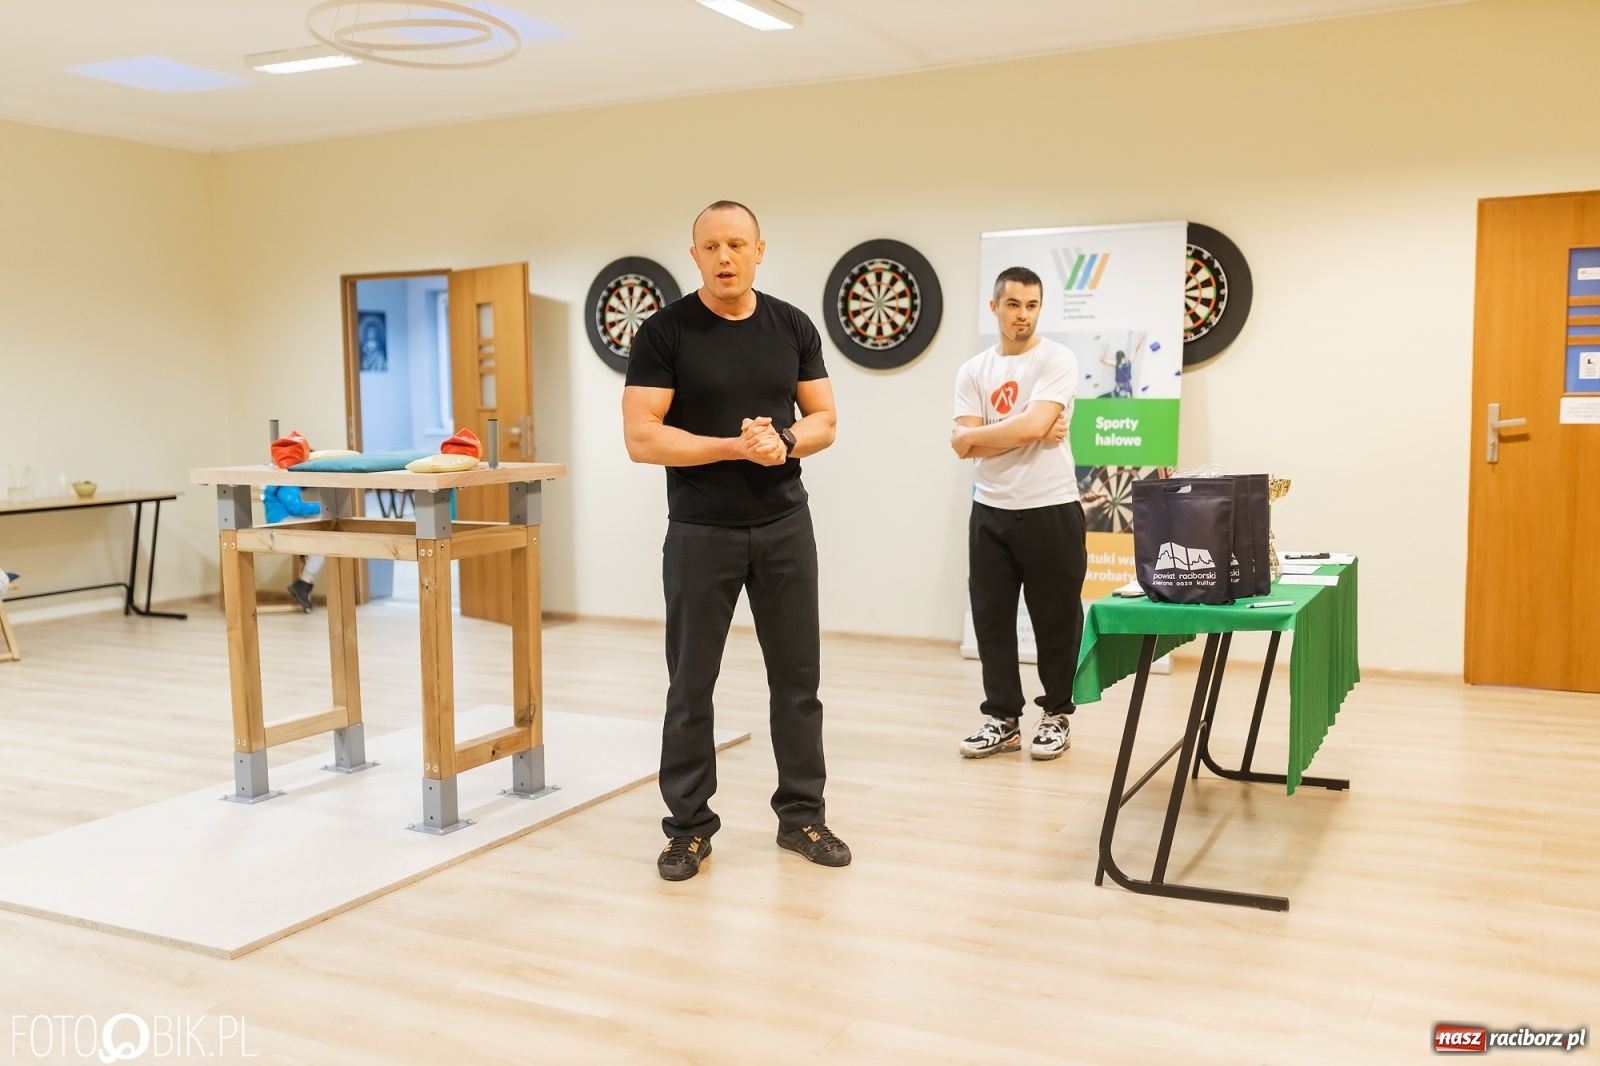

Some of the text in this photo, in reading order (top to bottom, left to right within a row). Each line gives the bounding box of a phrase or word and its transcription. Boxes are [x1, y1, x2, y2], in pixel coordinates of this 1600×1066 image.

[1095, 415, 1139, 431] Sporty
[1095, 432, 1142, 447] halowe
[1153, 571, 1217, 580] powiat raciborski
